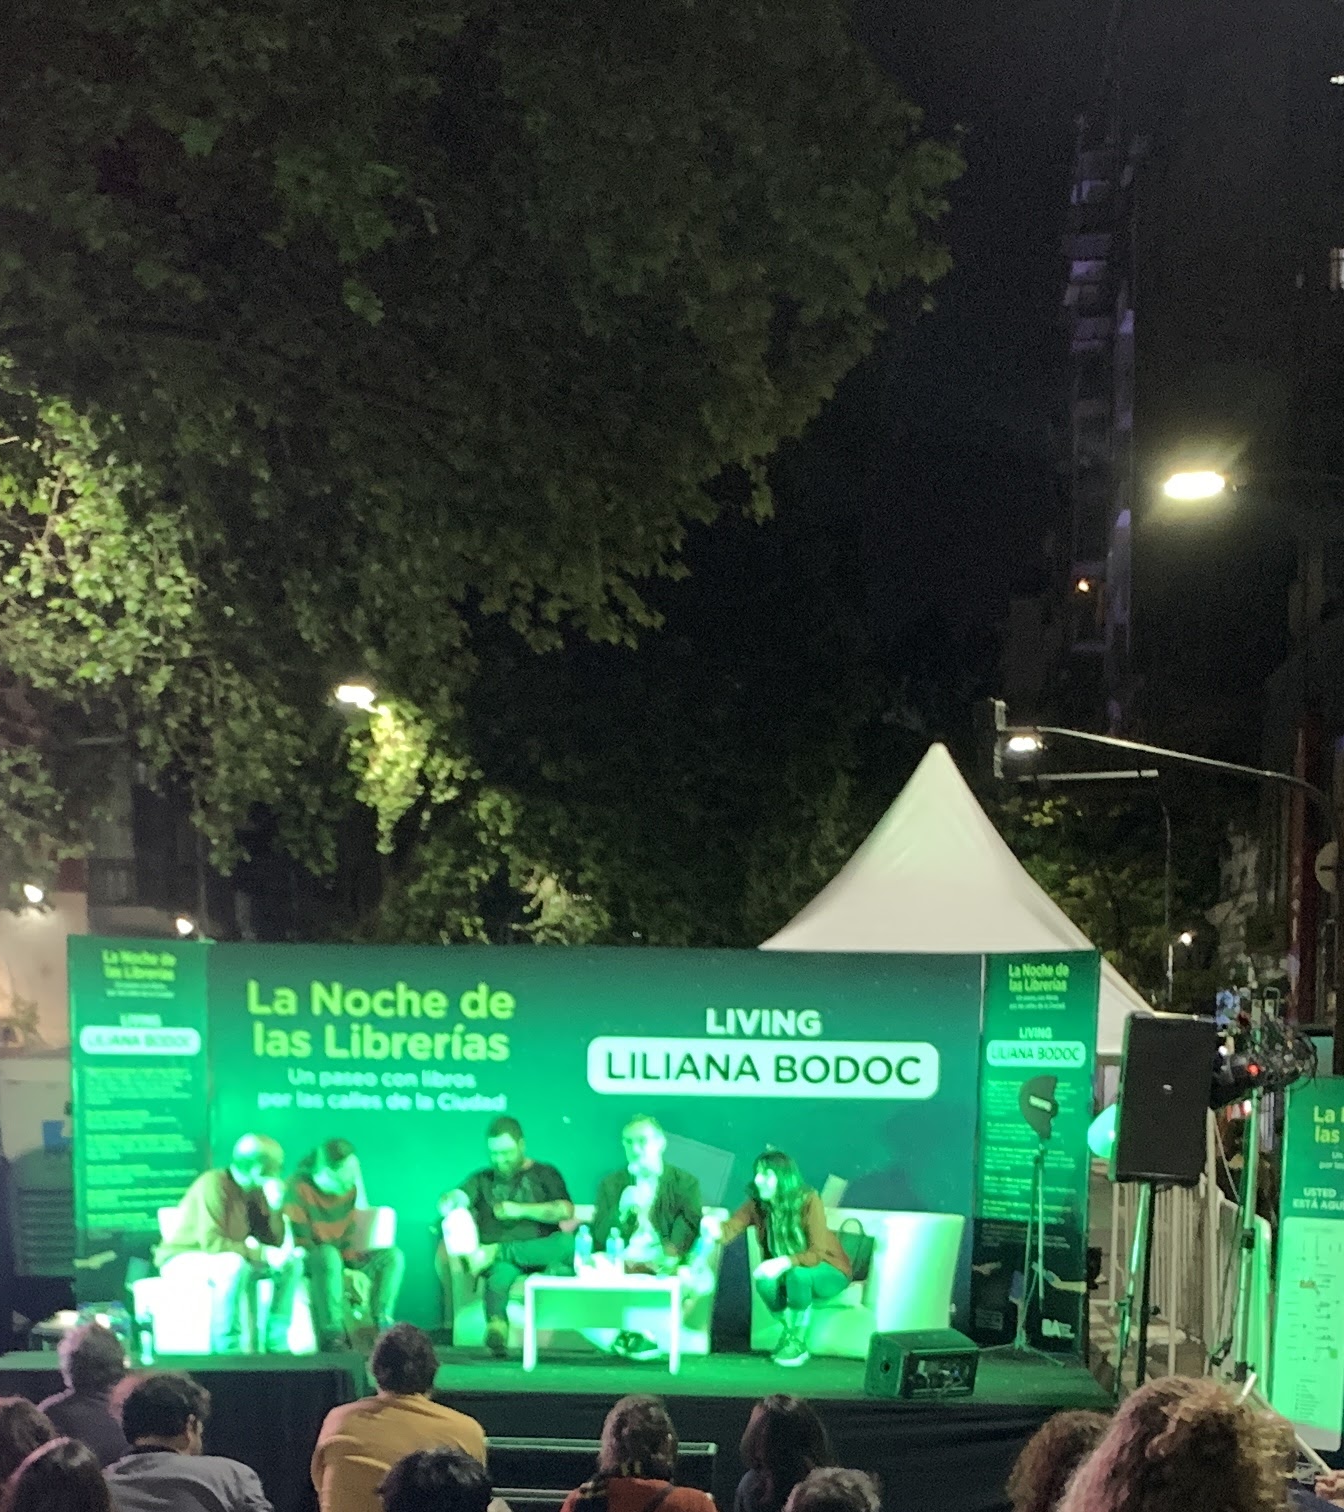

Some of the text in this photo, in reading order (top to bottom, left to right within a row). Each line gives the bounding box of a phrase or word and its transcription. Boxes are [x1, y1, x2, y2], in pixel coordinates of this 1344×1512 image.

[1008, 963, 1021, 978] La
[247, 978, 516, 1020] La Noche de
[706, 1007, 823, 1037] LIVING
[253, 1020, 510, 1061] las Librerías
[1019, 1026, 1052, 1039] LIVING
[287, 1067, 316, 1086] Un
[381, 1072, 419, 1088] con
[421, 1069, 477, 1089] libros
[607, 1051, 922, 1086] LILIANA BODOC
[1313, 1105, 1336, 1124] La
[1314, 1125, 1340, 1144] las
[1303, 1186, 1337, 1199] USTED
